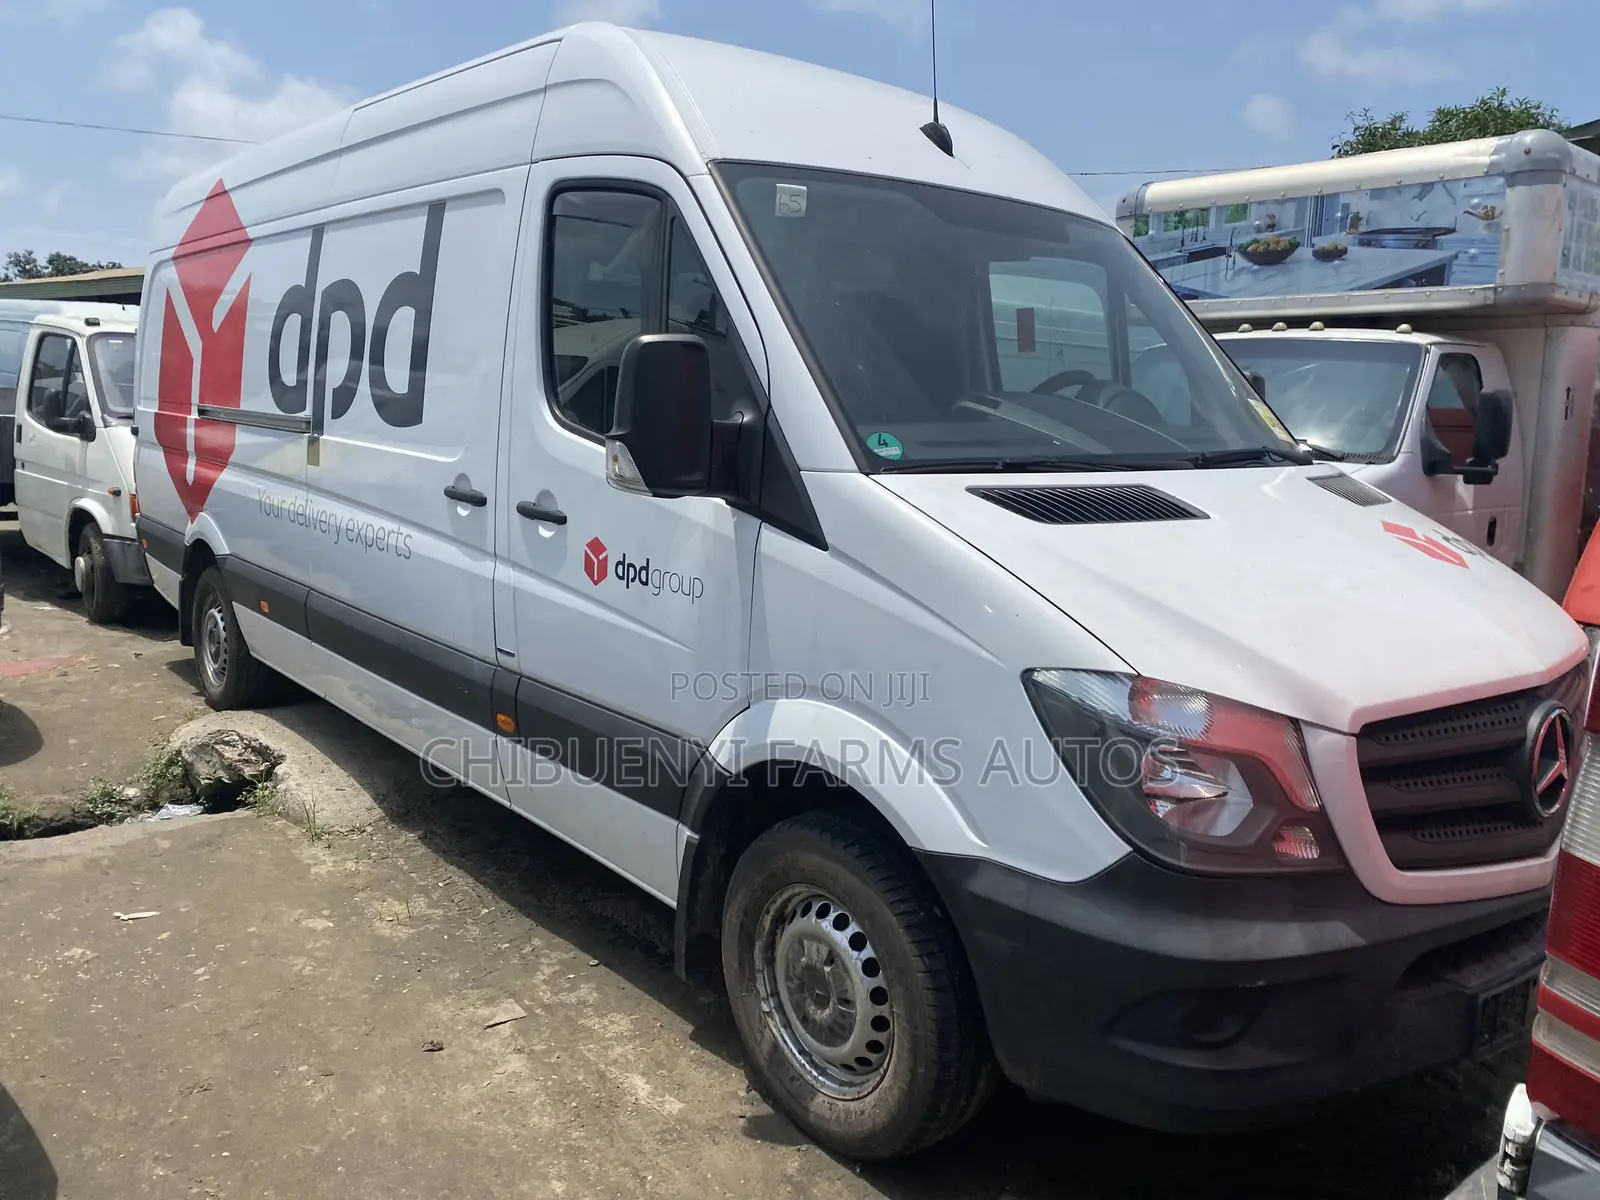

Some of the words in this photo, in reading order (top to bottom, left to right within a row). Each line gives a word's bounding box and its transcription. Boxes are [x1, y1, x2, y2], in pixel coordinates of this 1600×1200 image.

[779, 193, 802, 215] 65
[268, 201, 446, 436] dpd
[877, 433, 889, 447] 4
[257, 487, 286, 521] Your
[287, 489, 344, 545] delivery
[345, 518, 413, 560] experts
[614, 552, 704, 605] dpdgroup
